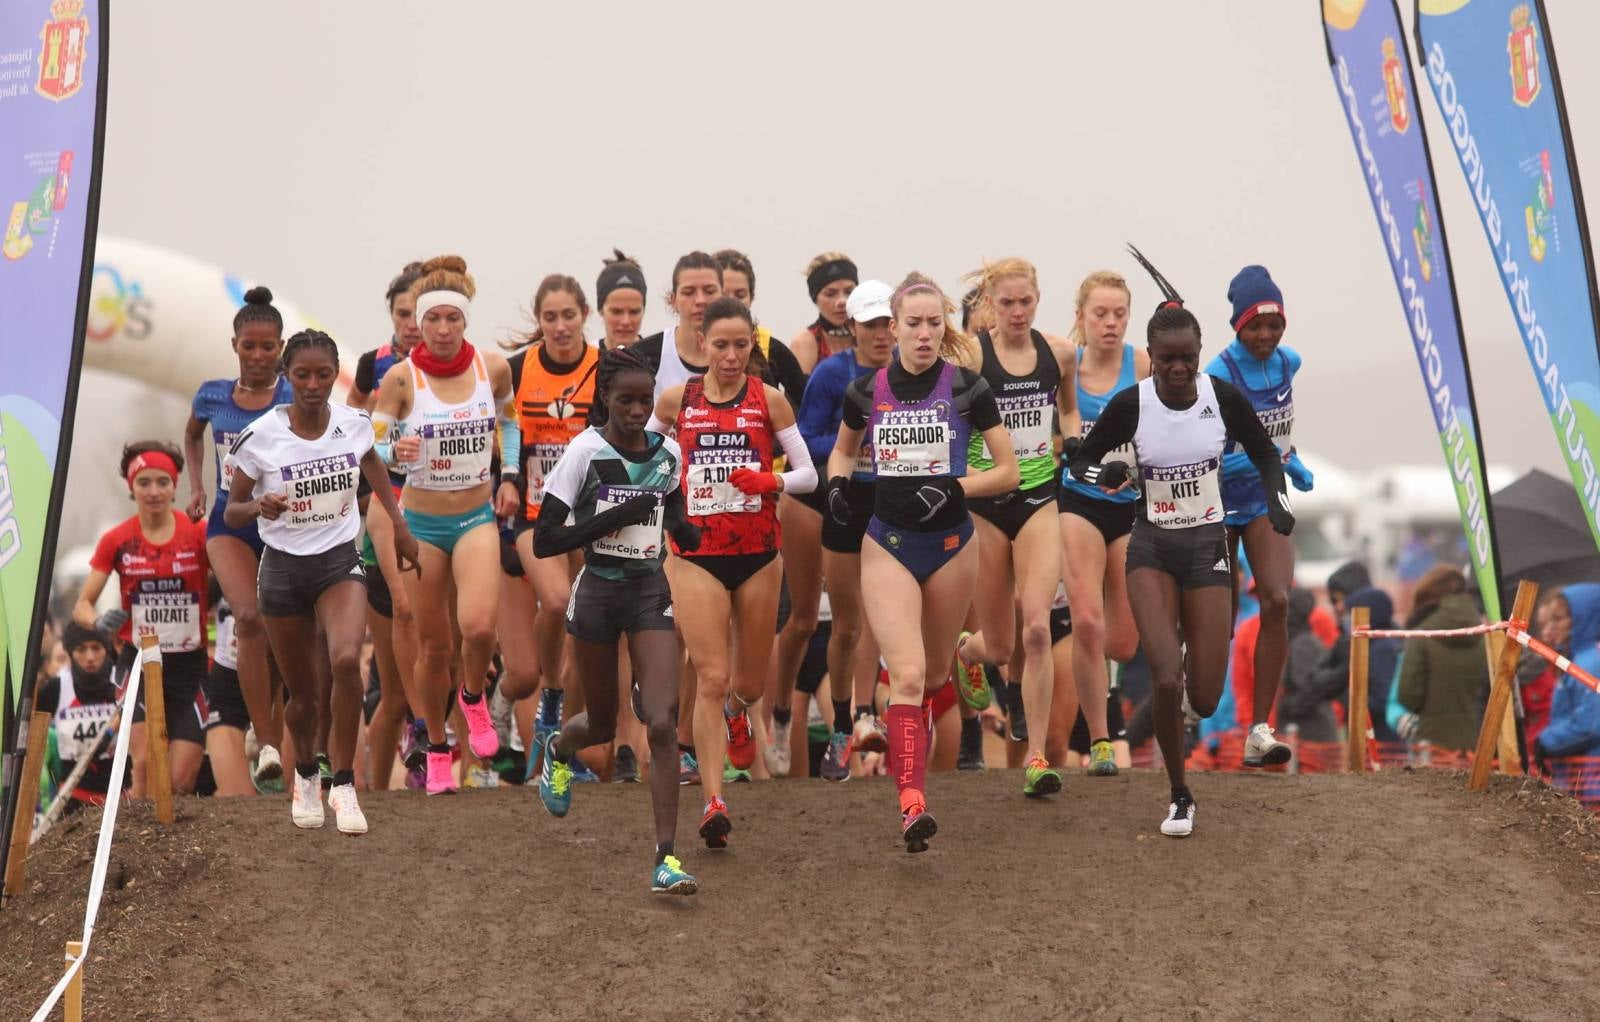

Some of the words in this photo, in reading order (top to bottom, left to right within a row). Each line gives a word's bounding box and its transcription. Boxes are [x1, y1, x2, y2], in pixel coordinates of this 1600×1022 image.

[1003, 381, 1041, 391] saucony
[995, 392, 1048, 404] DIPUTACIÓN
[882, 416, 938, 425] BURGOS
[1004, 410, 1041, 429] ARTER
[433, 420, 489, 432] DIPUTACIÓN
[434, 426, 489, 438] BURGOS
[718, 434, 745, 446] BM
[879, 426, 944, 445] PESCADOR
[440, 436, 486, 456] ROBLES
[694, 449, 752, 457] DIPUTACIÓN
[879, 448, 898, 460] 354
[290, 456, 348, 472] DIPUTACIÓN
[430, 459, 452, 470] 360
[695, 456, 751, 464] BURGOS
[291, 463, 350, 480] BURGOS
[1152, 461, 1210, 474] DIPUTACIÓN
[430, 473, 471, 483] iberCaja
[703, 465, 746, 483] A.DI
[1152, 467, 1210, 481] BURGOS
[294, 472, 353, 498] SENBERE
[1171, 480, 1201, 500] KITE
[693, 487, 713, 499] 322
[291, 500, 313, 512] 301
[607, 495, 661, 506] BUS
[1154, 502, 1176, 513] 304
[291, 513, 335, 525] iberCaja
[1154, 516, 1197, 526] iberCaja
[596, 540, 640, 555] iberCaja
[158, 579, 181, 590] BM
[145, 608, 190, 623] LOIZATE
[899, 718, 918, 785] kalenji
